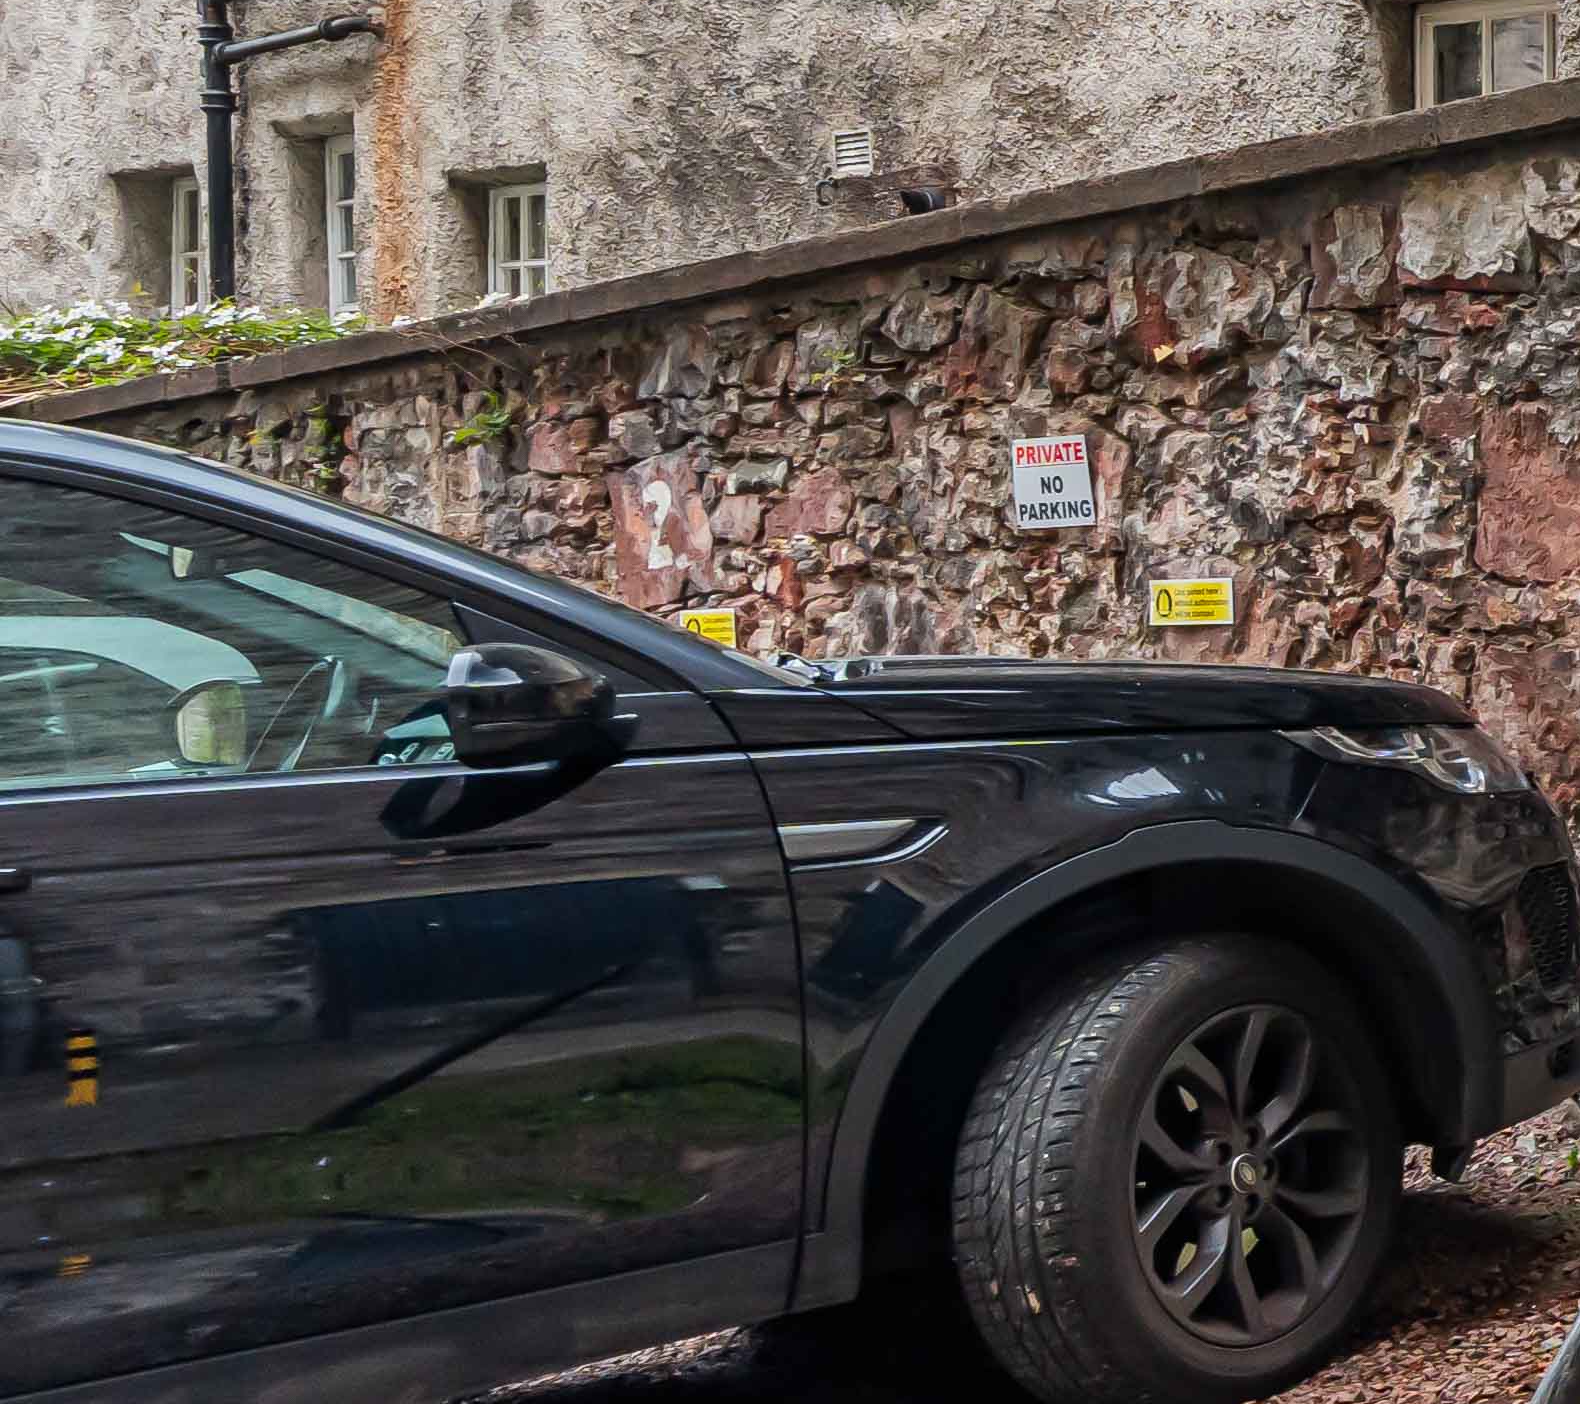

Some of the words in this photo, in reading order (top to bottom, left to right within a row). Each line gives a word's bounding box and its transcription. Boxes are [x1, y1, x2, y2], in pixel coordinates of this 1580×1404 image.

[1016, 442, 1085, 466] PRIVATE
[1040, 475, 1063, 494] NO
[1019, 499, 1092, 521] PARKING
